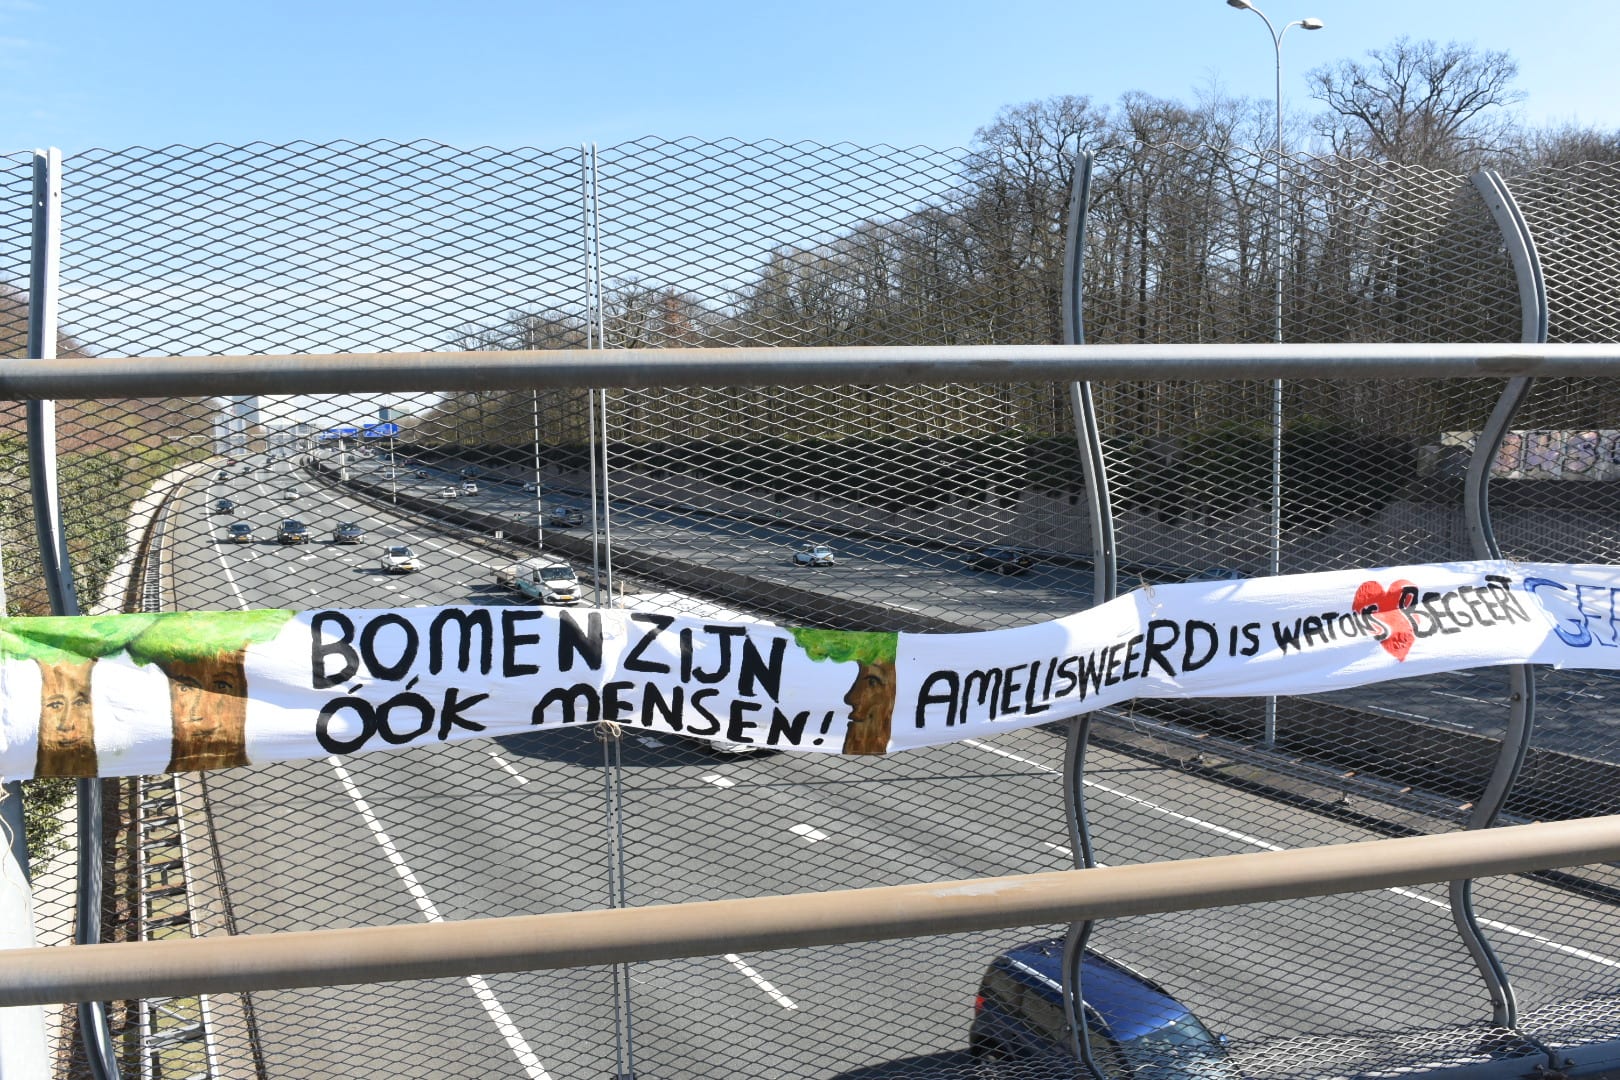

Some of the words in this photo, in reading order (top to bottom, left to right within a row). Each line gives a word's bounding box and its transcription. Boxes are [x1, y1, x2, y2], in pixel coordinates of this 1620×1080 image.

[311, 608, 603, 689] BOMEN
[624, 612, 788, 702] ZIJN
[915, 619, 1219, 729] AMELISWEERD
[1229, 622, 1261, 657] IS
[531, 680, 835, 746] MENSEN!
